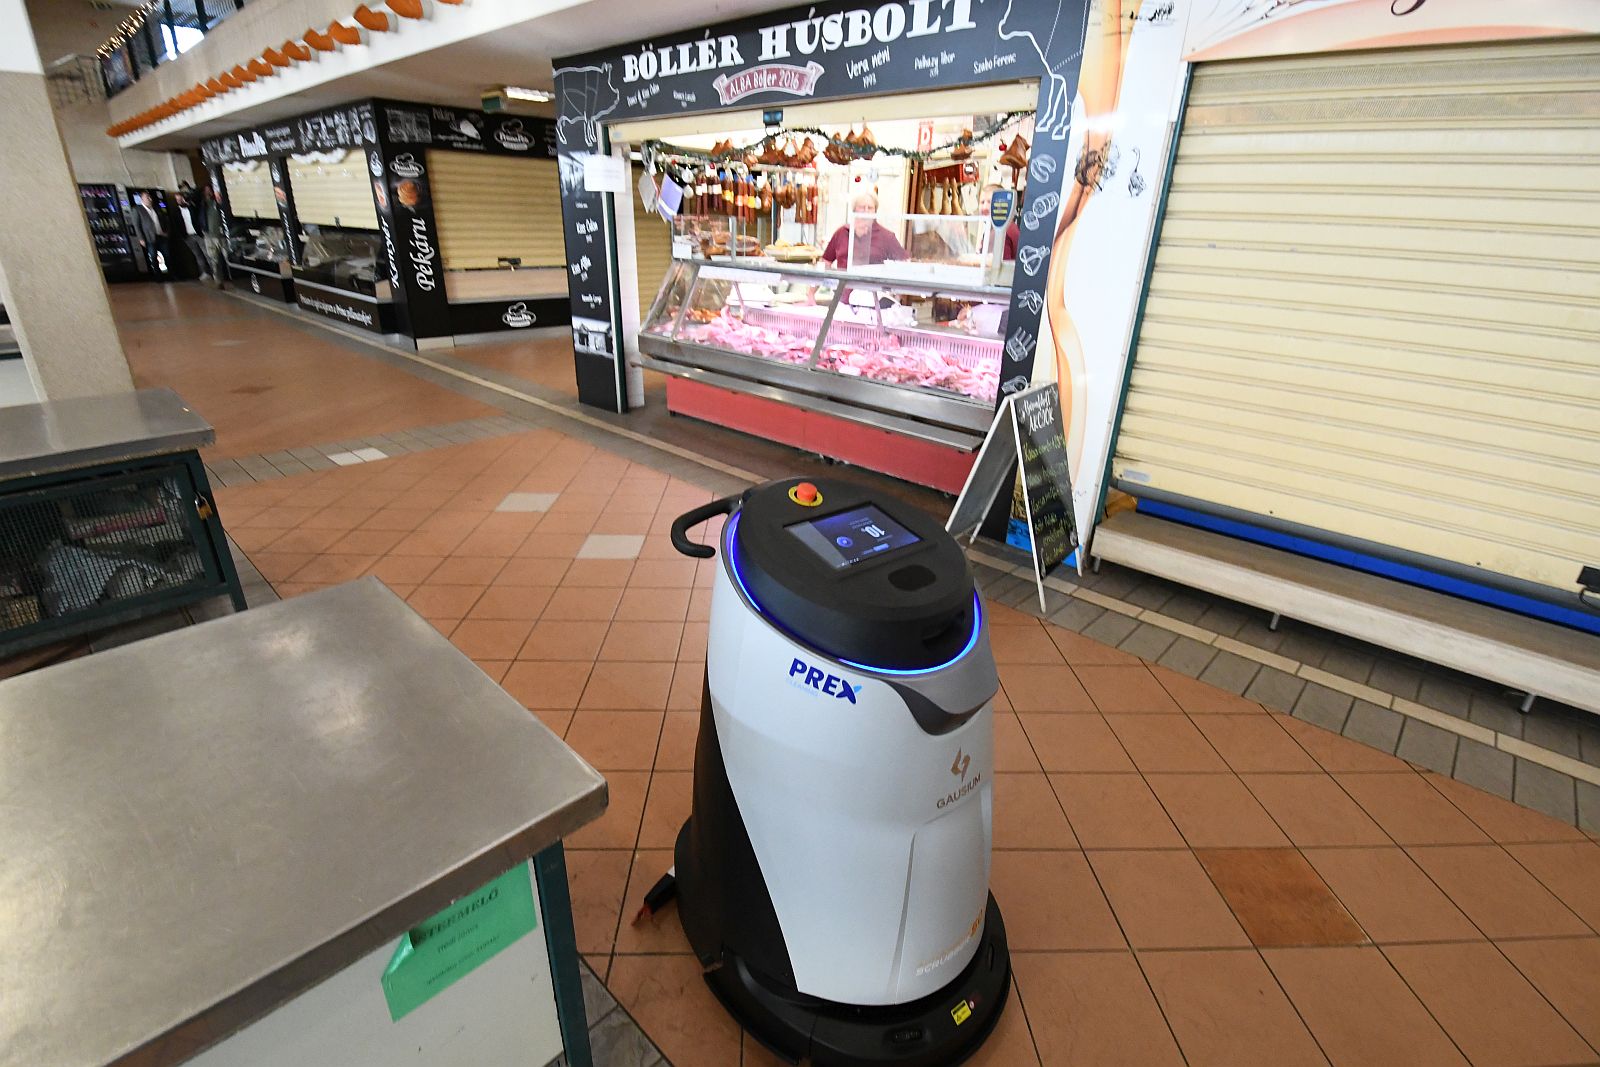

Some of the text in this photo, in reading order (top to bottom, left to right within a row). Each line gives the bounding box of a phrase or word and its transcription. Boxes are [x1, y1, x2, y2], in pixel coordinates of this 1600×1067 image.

[622, 0, 977, 83] BÖLLÉR HÚSBOLT
[730, 73, 752, 97] ALBA
[409, 217, 436, 292] Pékáru
[789, 657, 863, 705] PREX
[936, 772, 981, 810] GAUSIUM
